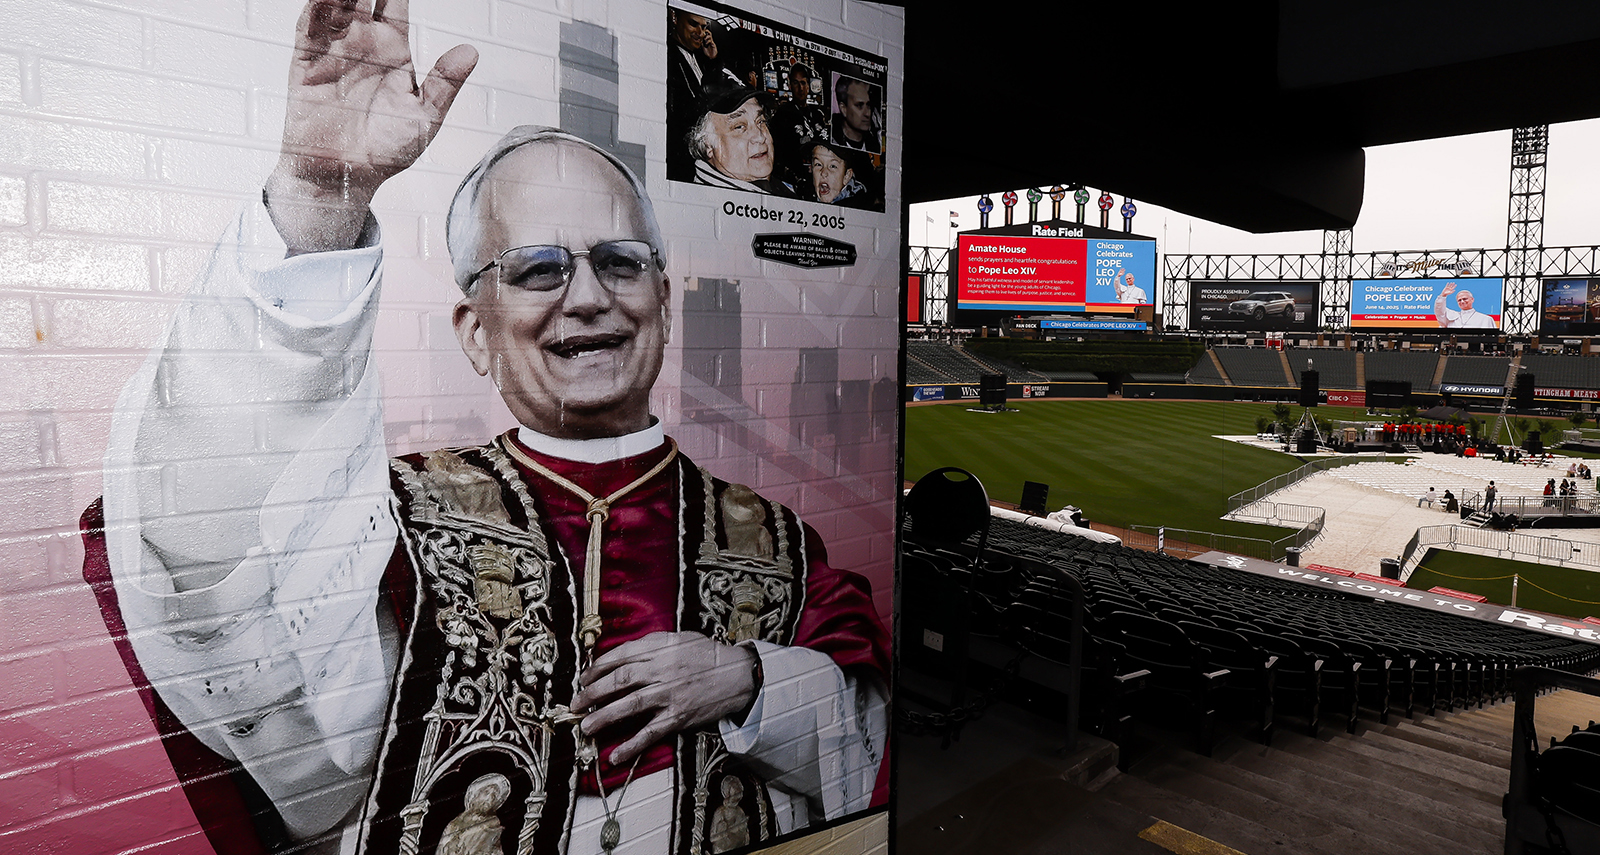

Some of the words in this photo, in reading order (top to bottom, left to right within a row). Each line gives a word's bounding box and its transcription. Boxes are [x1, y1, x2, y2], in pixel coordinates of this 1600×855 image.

[742, 20, 756, 32] HOU
[775, 30, 791, 43] CHW
[723, 201, 784, 222] October
[788, 210, 808, 228] 22,
[812, 213, 846, 230] 2005
[1032, 224, 1057, 237] Rate
[1058, 228, 1083, 237] Field
[792, 236, 824, 246] WARNING!
[968, 244, 998, 253] Amate
[999, 245, 1027, 254] House
[1096, 242, 1124, 251] Chicago
[786, 250, 806, 258] LEAVING
[1096, 250, 1133, 258] Celebrates
[1096, 259, 1122, 268] POPE
[1406, 258, 1446, 274] Miller
[978, 266, 1001, 275] Pope
[1002, 266, 1019, 275] Leo
[1096, 268, 1115, 277] LEO
[1095, 278, 1112, 286] XIV
[1365, 294, 1392, 302] POPE
[1393, 294, 1414, 302] LEO
[1415, 293, 1433, 302] XIV
[1573, 390, 1598, 398] MEATS
[1277, 568, 1423, 601] WELCOME
[1433, 598, 1476, 612] TO
[1497, 610, 1600, 640] Rat
